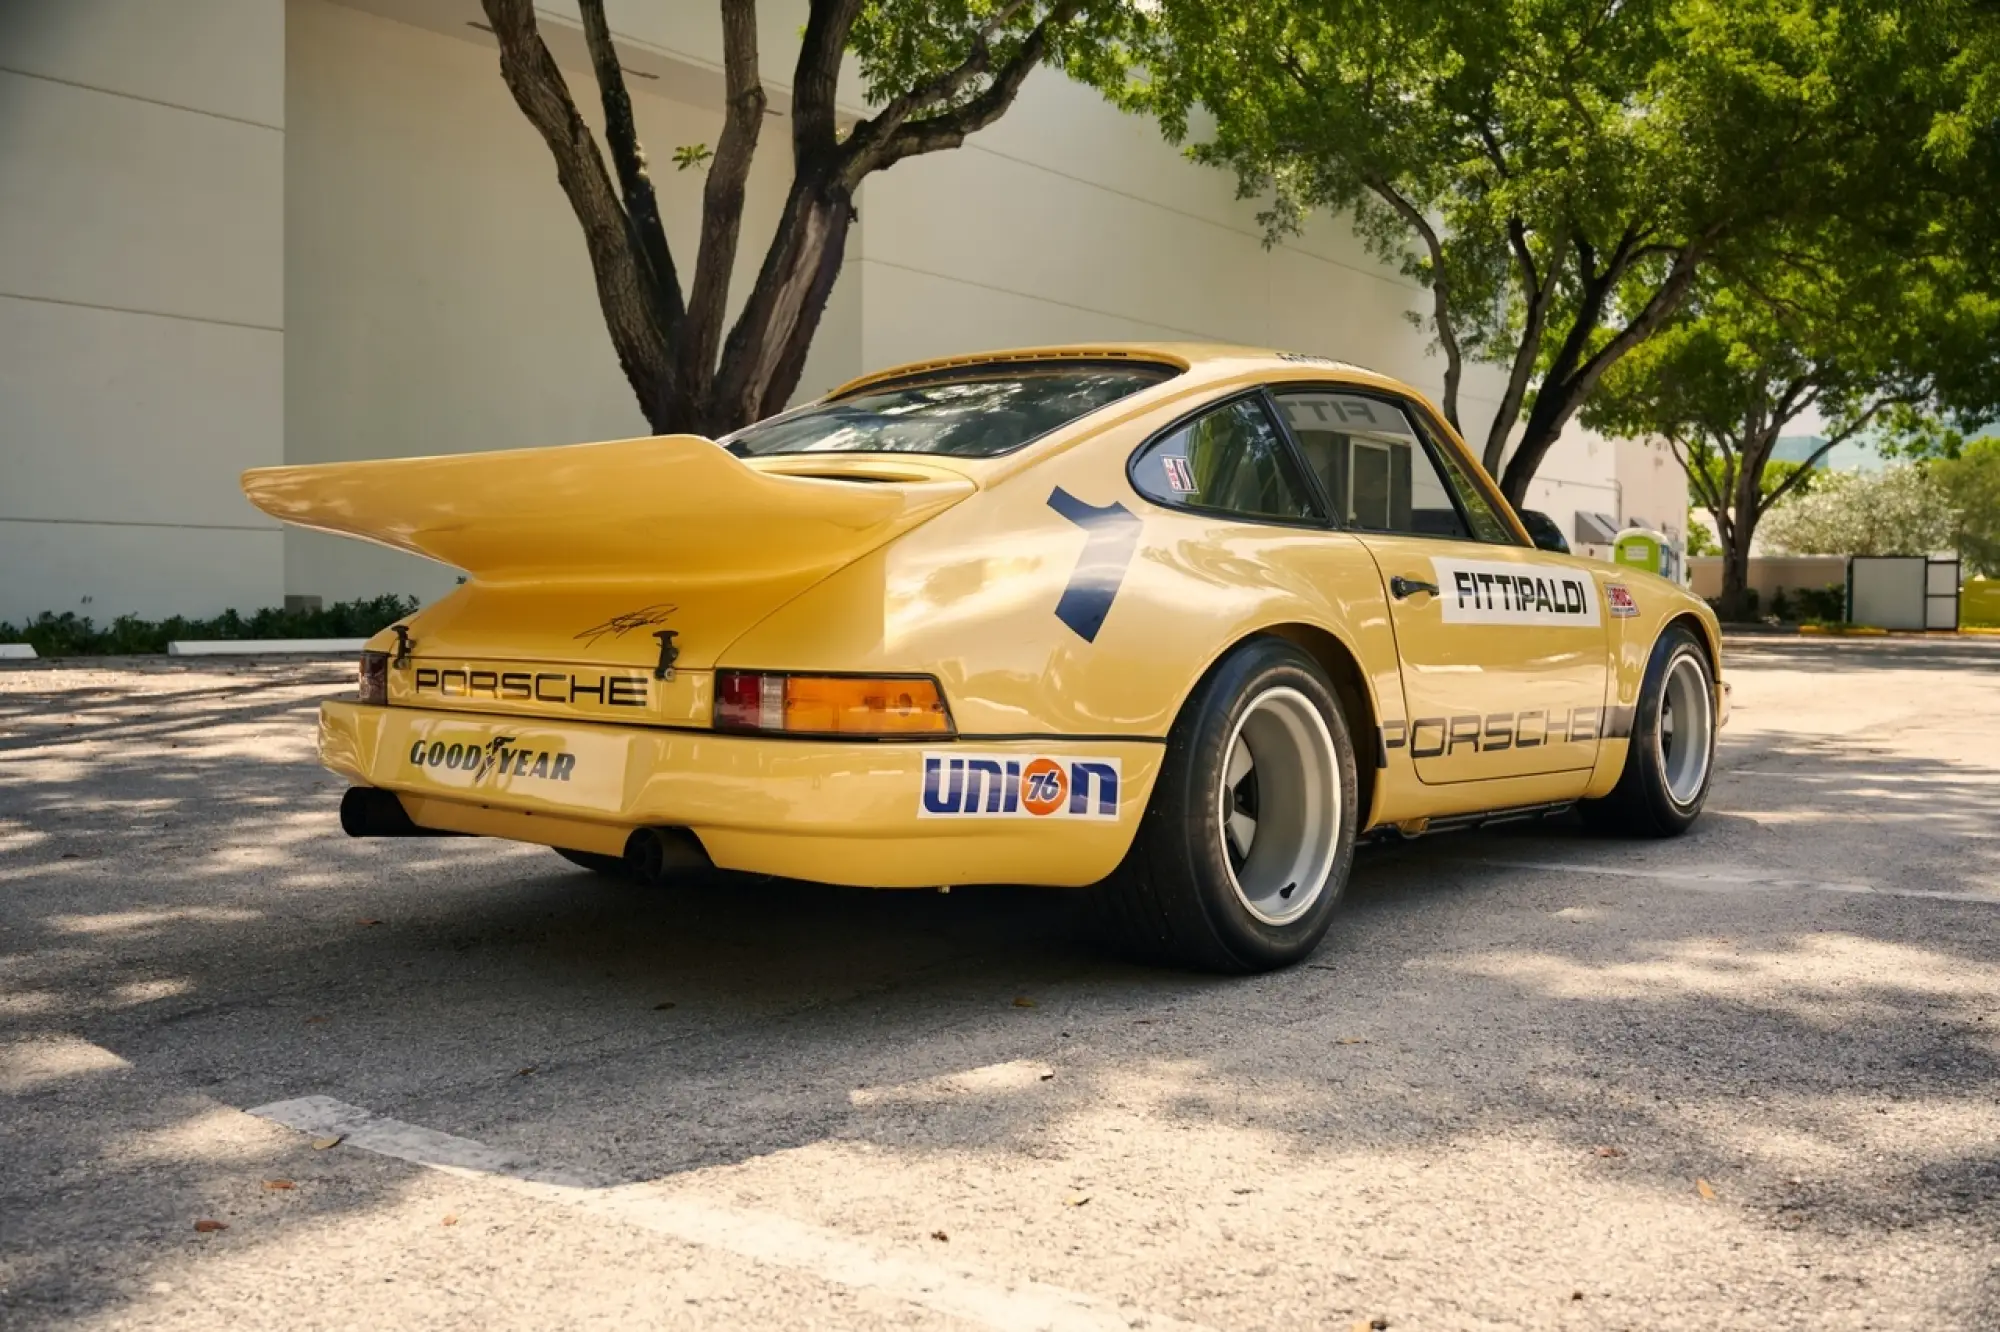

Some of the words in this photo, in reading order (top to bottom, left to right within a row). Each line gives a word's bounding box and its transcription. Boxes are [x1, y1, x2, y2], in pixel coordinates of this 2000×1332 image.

[1453, 571, 1587, 614] FITTIPALDI
[416, 668, 648, 706] PORSCHE
[1383, 708, 1598, 759] PORSCHE
[1027, 769, 1061, 802] 76
